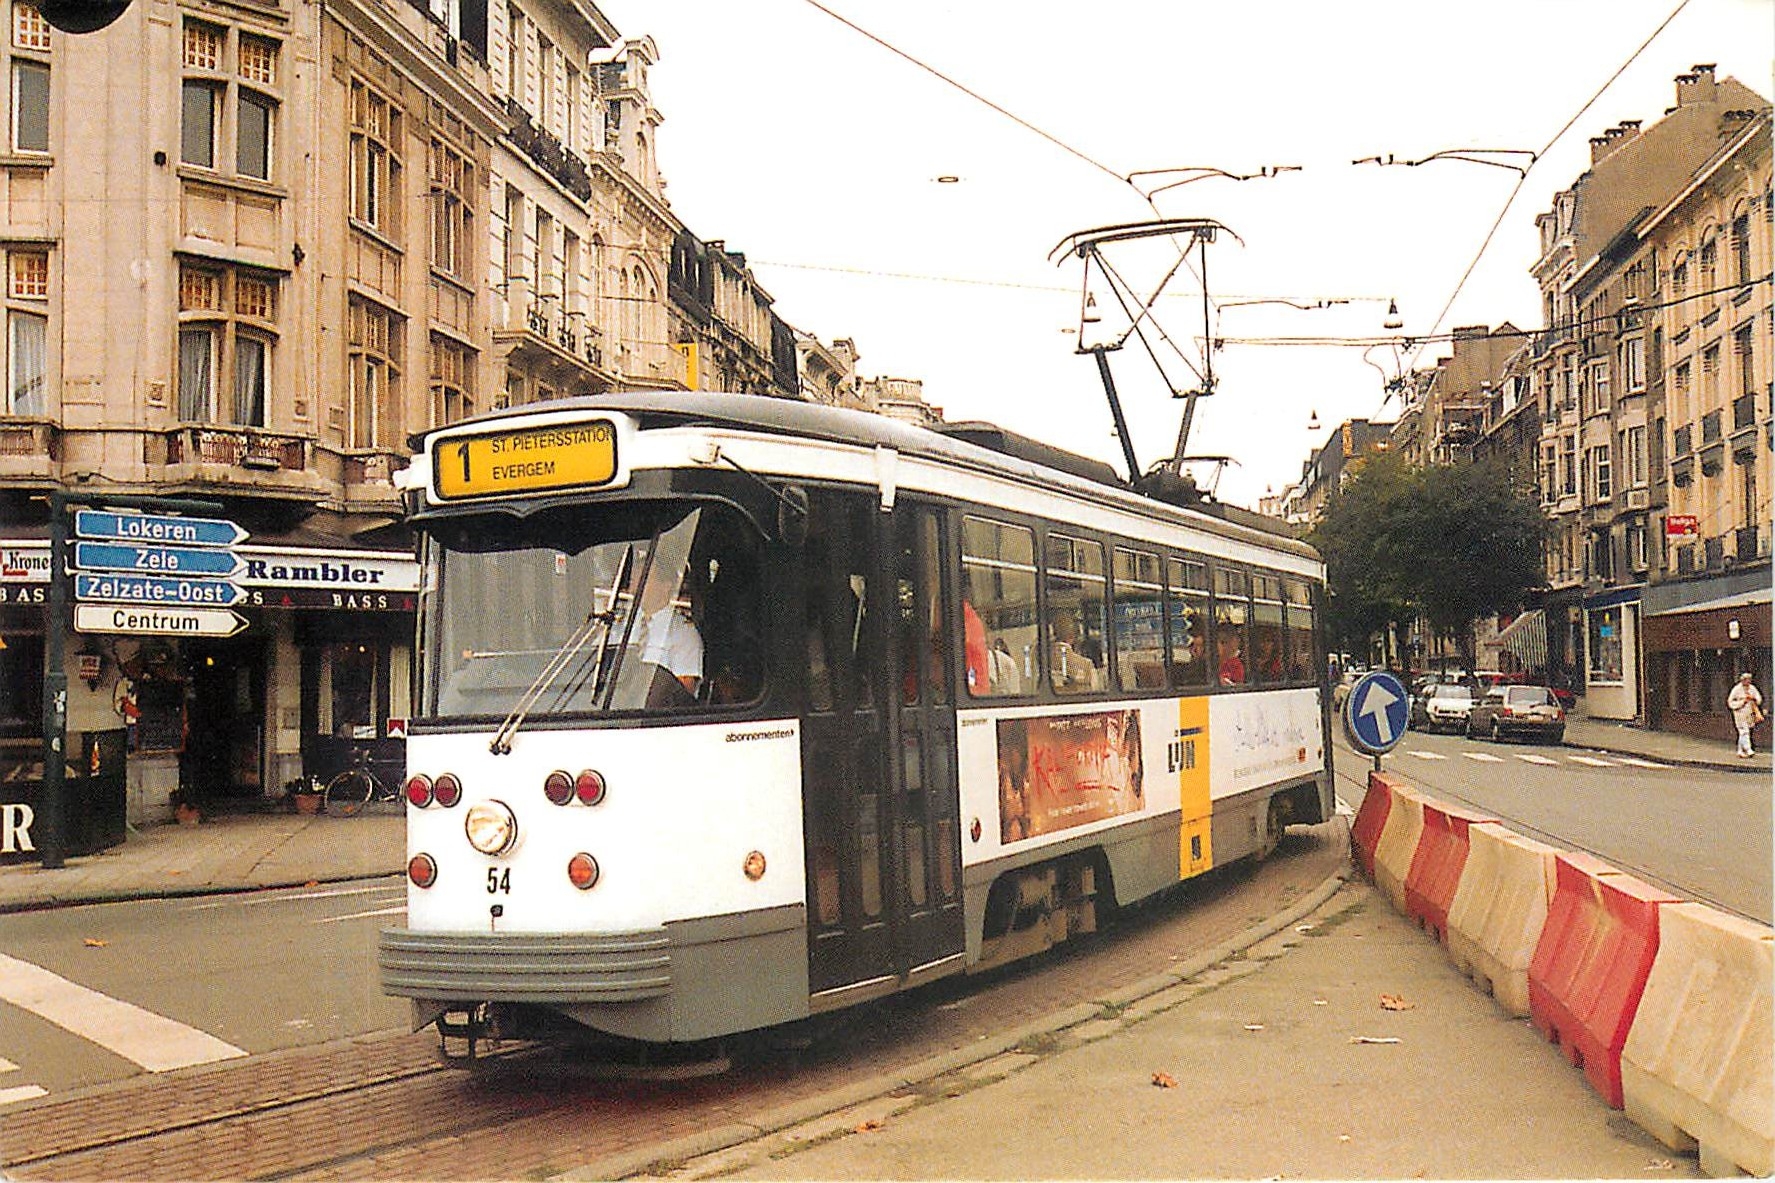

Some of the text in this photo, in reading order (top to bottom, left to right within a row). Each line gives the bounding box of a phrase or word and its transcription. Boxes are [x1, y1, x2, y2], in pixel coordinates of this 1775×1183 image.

[492, 439, 510, 454] ST.
[457, 442, 471, 483] 1
[493, 461, 555, 480] EVERGEM
[117, 517, 197, 540] Lokeren
[135, 549, 179, 569] Zele
[246, 559, 384, 583] Rambler
[87, 577, 224, 602] Zelzate-Oost
[332, 593, 388, 608] BASS
[113, 610, 199, 630] Centrum
[0, 803, 36, 852] R
[487, 867, 511, 894] 54
